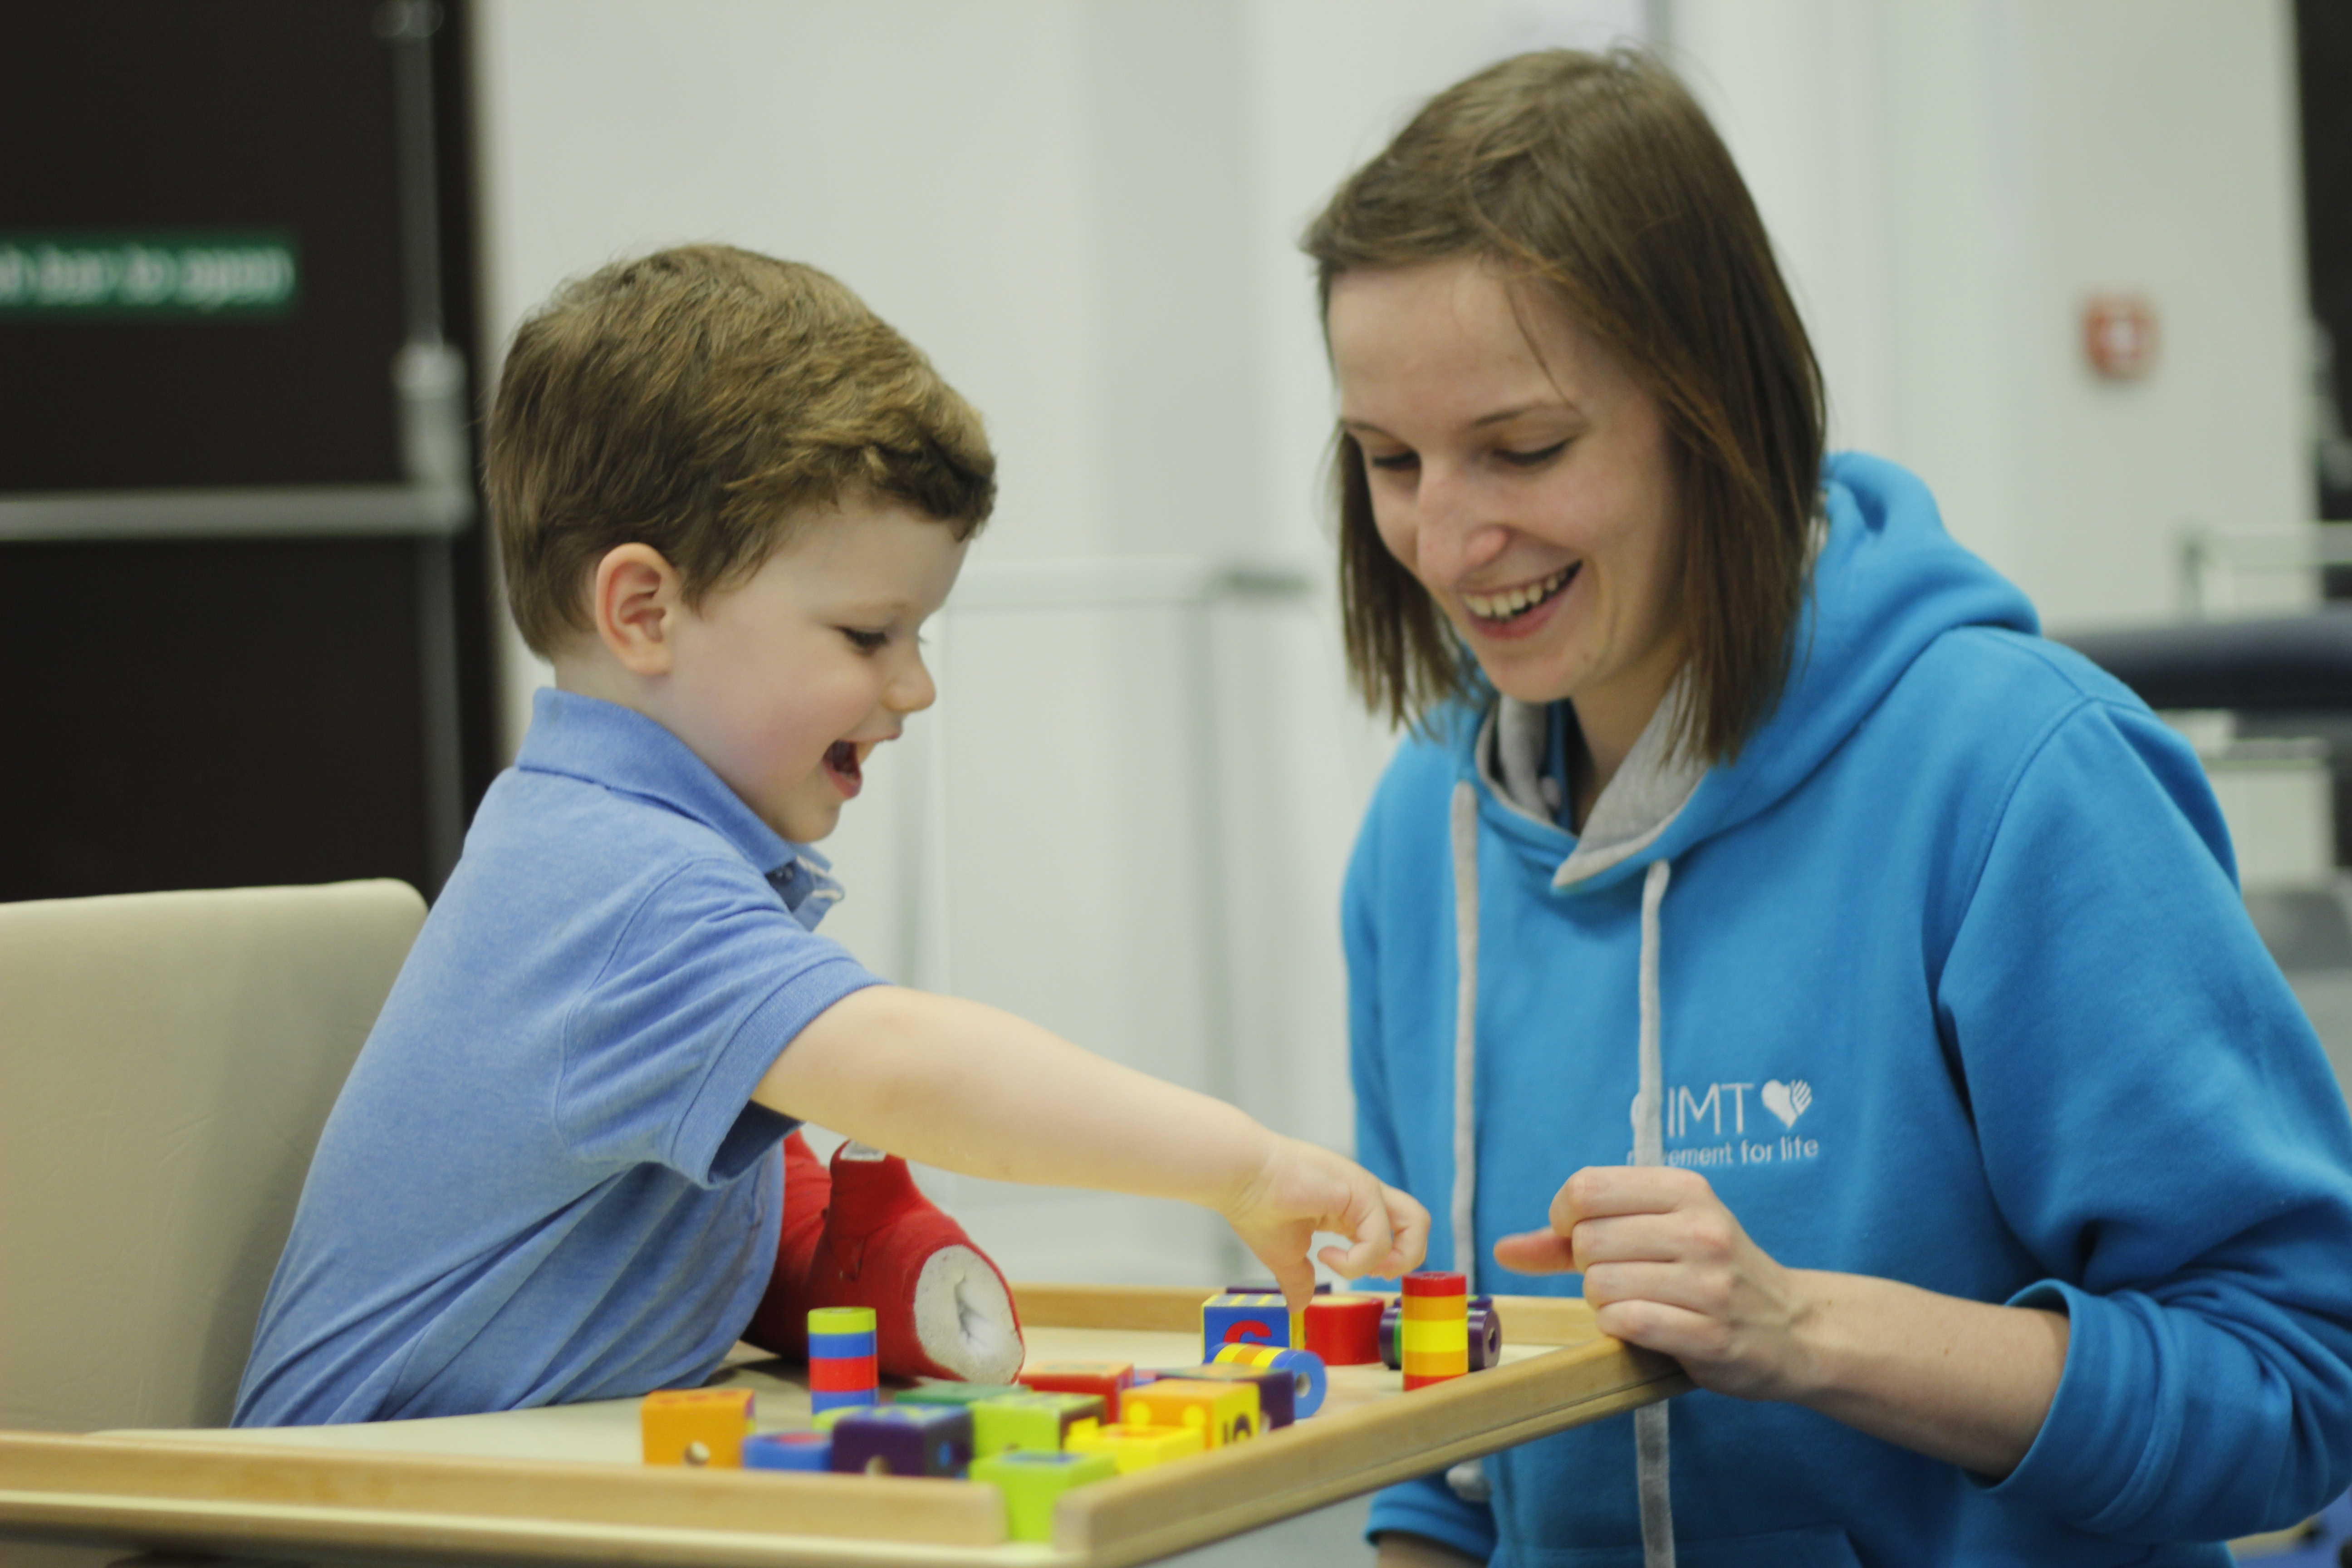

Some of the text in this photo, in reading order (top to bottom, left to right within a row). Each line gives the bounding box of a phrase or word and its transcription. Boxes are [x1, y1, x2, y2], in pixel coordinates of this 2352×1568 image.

[1630, 1083, 1754, 1137] IMT
[1627, 1135, 1819, 1166] ement for life
